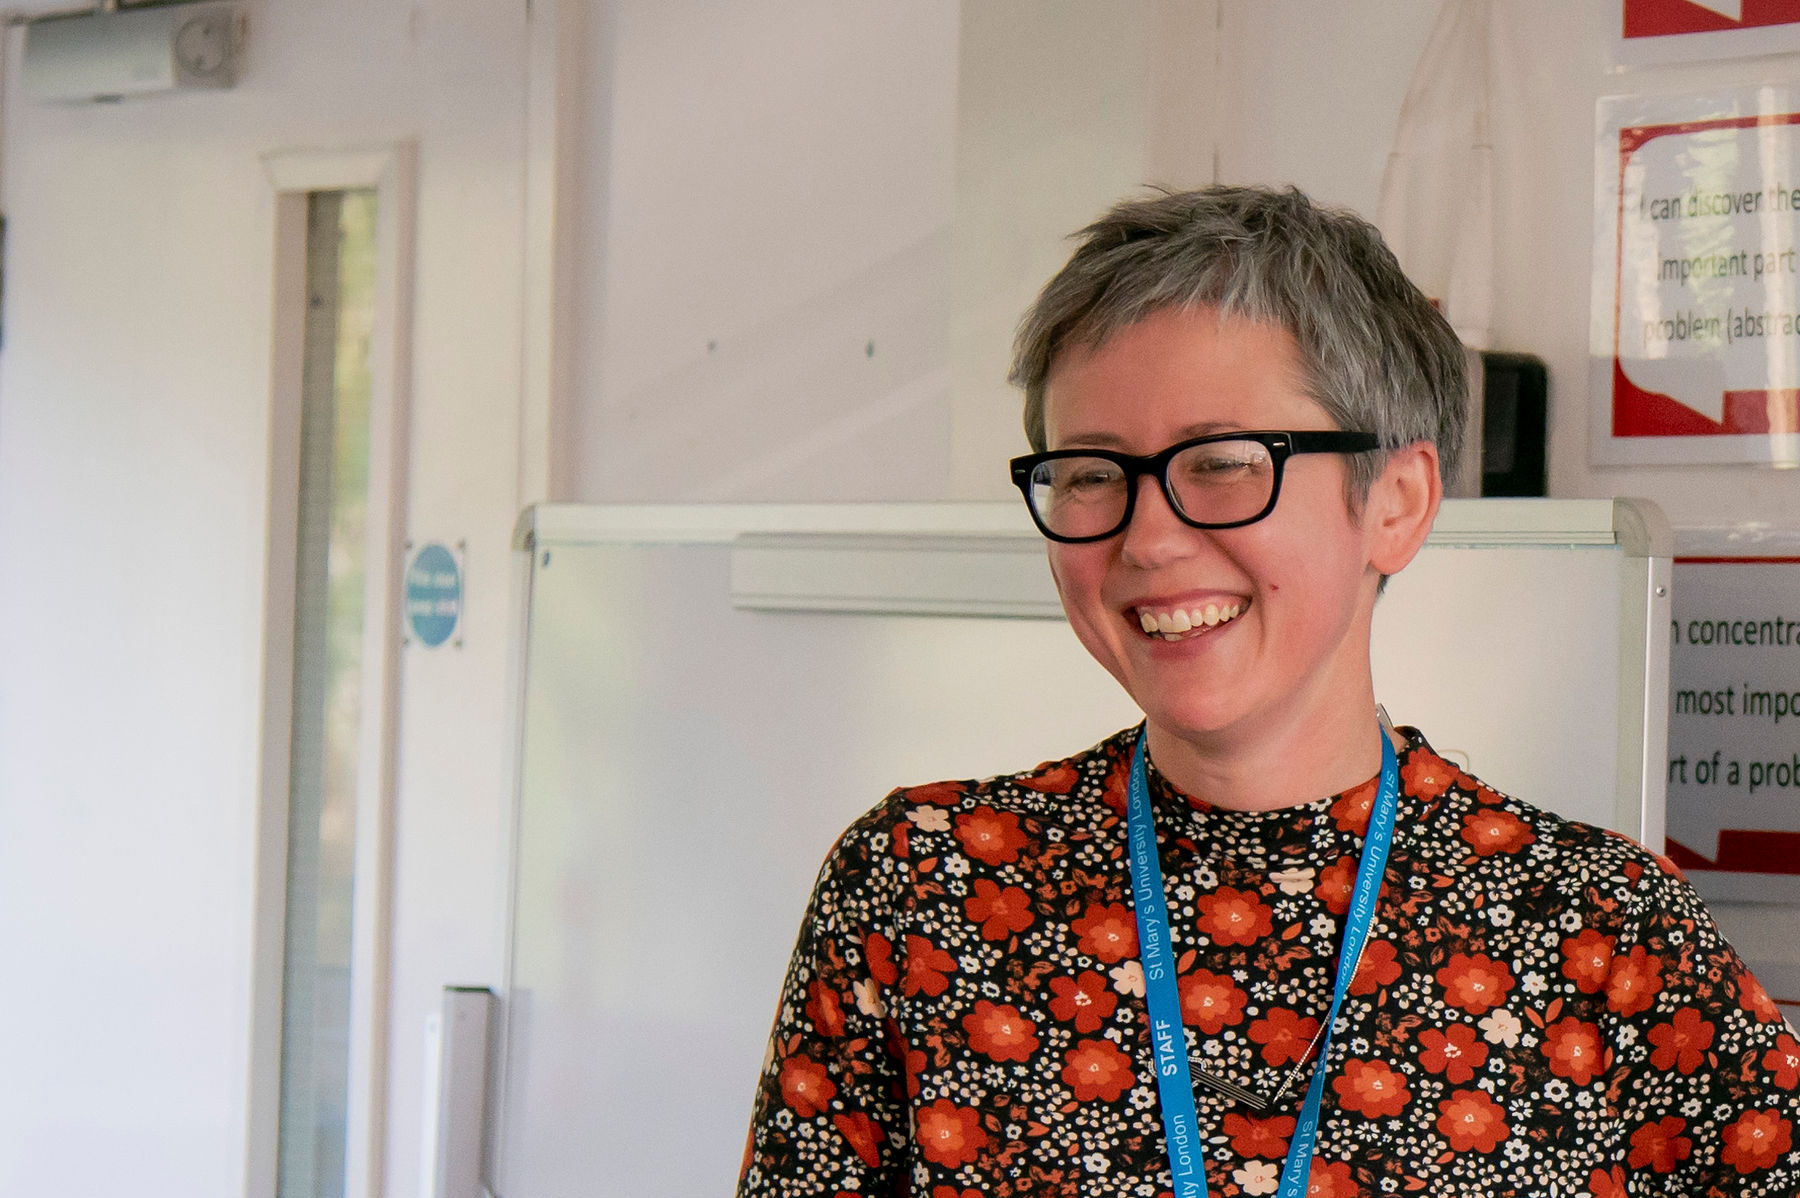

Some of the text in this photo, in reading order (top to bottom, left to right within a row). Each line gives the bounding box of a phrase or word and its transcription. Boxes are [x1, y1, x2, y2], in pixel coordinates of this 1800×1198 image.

[1650, 196, 1682, 220] can
[1687, 189, 1763, 217] discover
[1657, 250, 1749, 286] important
[1753, 247, 1797, 282] part
[1643, 309, 1721, 349] problem
[1675, 685, 1735, 716] most
[1695, 750, 1721, 785] of
[1727, 760, 1740, 785] a
[1131, 761, 1164, 982] St Mary's University London
[1340, 770, 1396, 987] St Mary's University London
[1156, 1019, 1178, 1077] STAFF
[1174, 1114, 1193, 1176] London
[1301, 1120, 1313, 1140] St
[1287, 1141, 1311, 1198] Mary's
